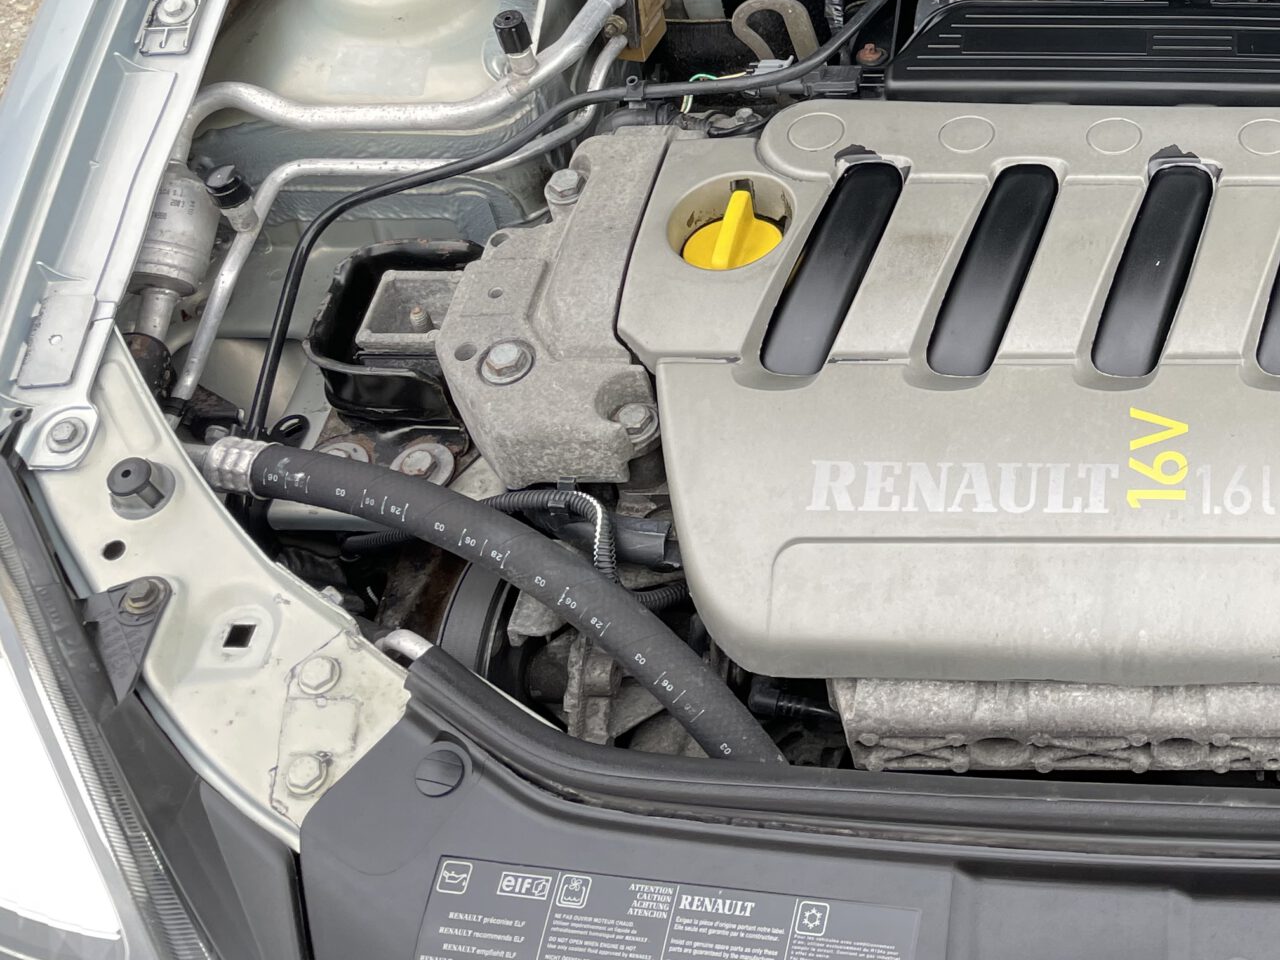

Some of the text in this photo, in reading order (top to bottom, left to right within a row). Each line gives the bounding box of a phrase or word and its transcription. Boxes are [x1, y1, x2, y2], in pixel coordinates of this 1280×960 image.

[805, 459, 1120, 515] RENAULT
[1126, 407, 1189, 509] 16V
[434, 522, 445, 532] 03
[490, 550, 503, 561] 28
[534, 576, 546, 587] 03
[590, 616, 603, 628] 28
[634, 653, 646, 665] 03
[502, 876, 532, 893] elf
[629, 883, 674, 895] ATTENTION
[636, 893, 672, 903] CAUTION
[632, 900, 670, 911] ACHTUNG
[679, 894, 755, 917] RENAULT
[448, 911, 483, 922] RENAULT
[438, 926, 472, 937] RENAULT
[442, 942, 476, 954] RENAULT
